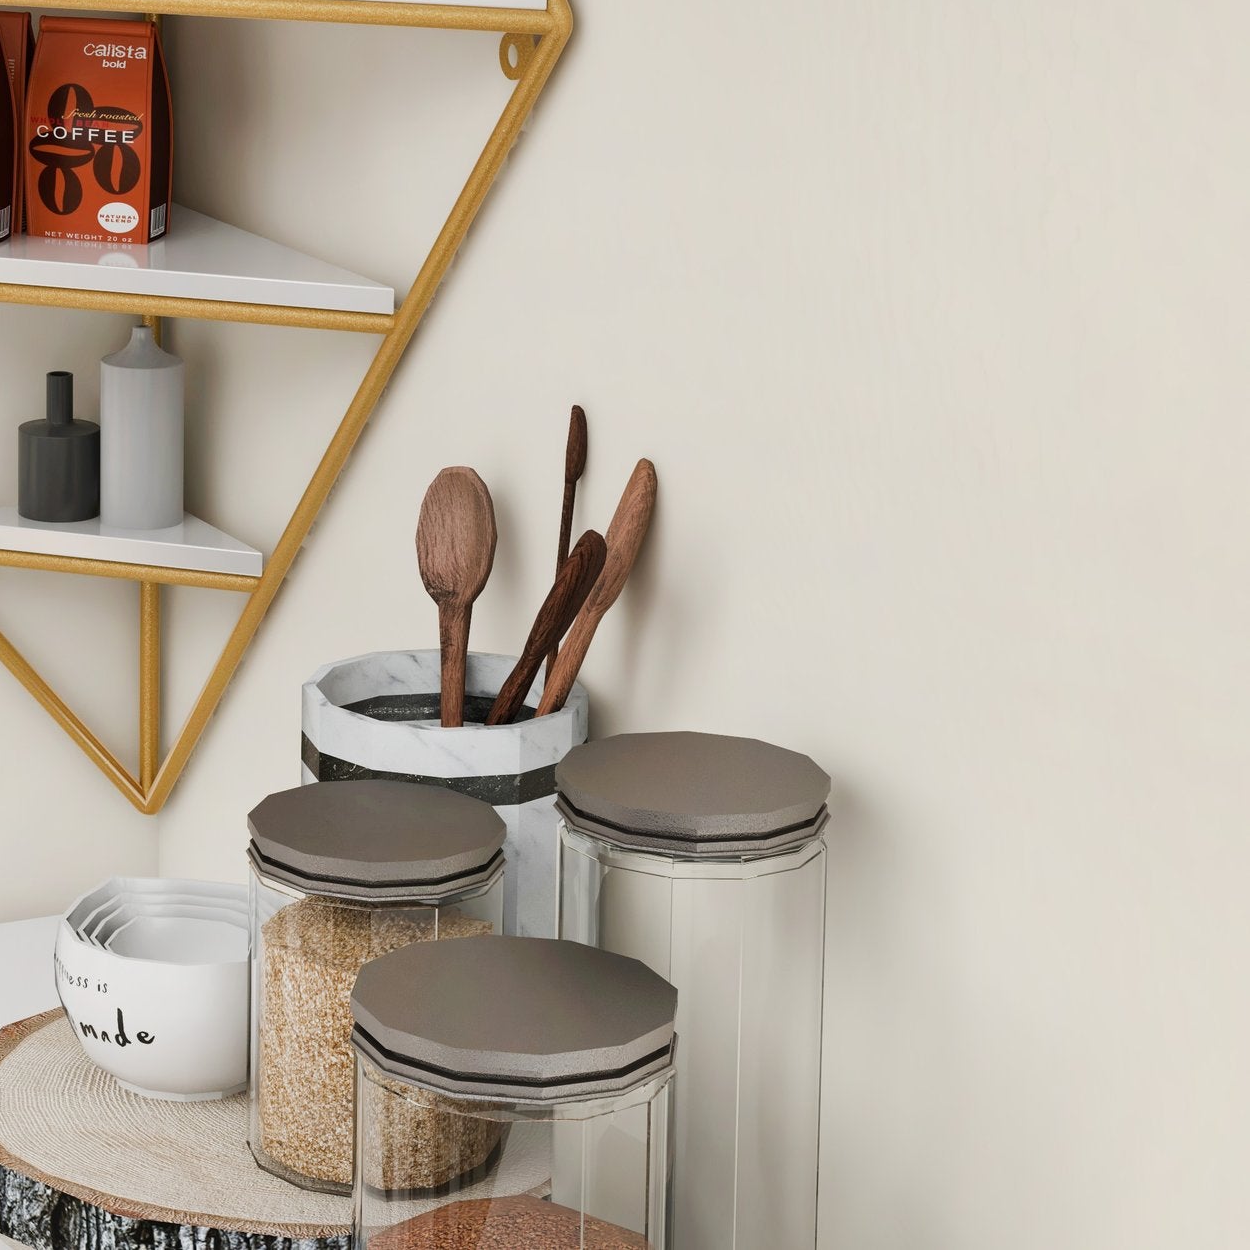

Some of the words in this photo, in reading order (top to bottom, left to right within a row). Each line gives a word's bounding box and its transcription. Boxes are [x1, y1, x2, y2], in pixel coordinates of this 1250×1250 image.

[102, 59, 126, 69] bold
[31, 116, 70, 126] WHOL
[61, 108, 97, 120] fresh
[99, 112, 144, 122] roasted
[36, 124, 135, 144] COFFEE
[45, 230, 62, 238] NET
[66, 232, 103, 241] WEIGHT
[97, 979, 108, 993] is
